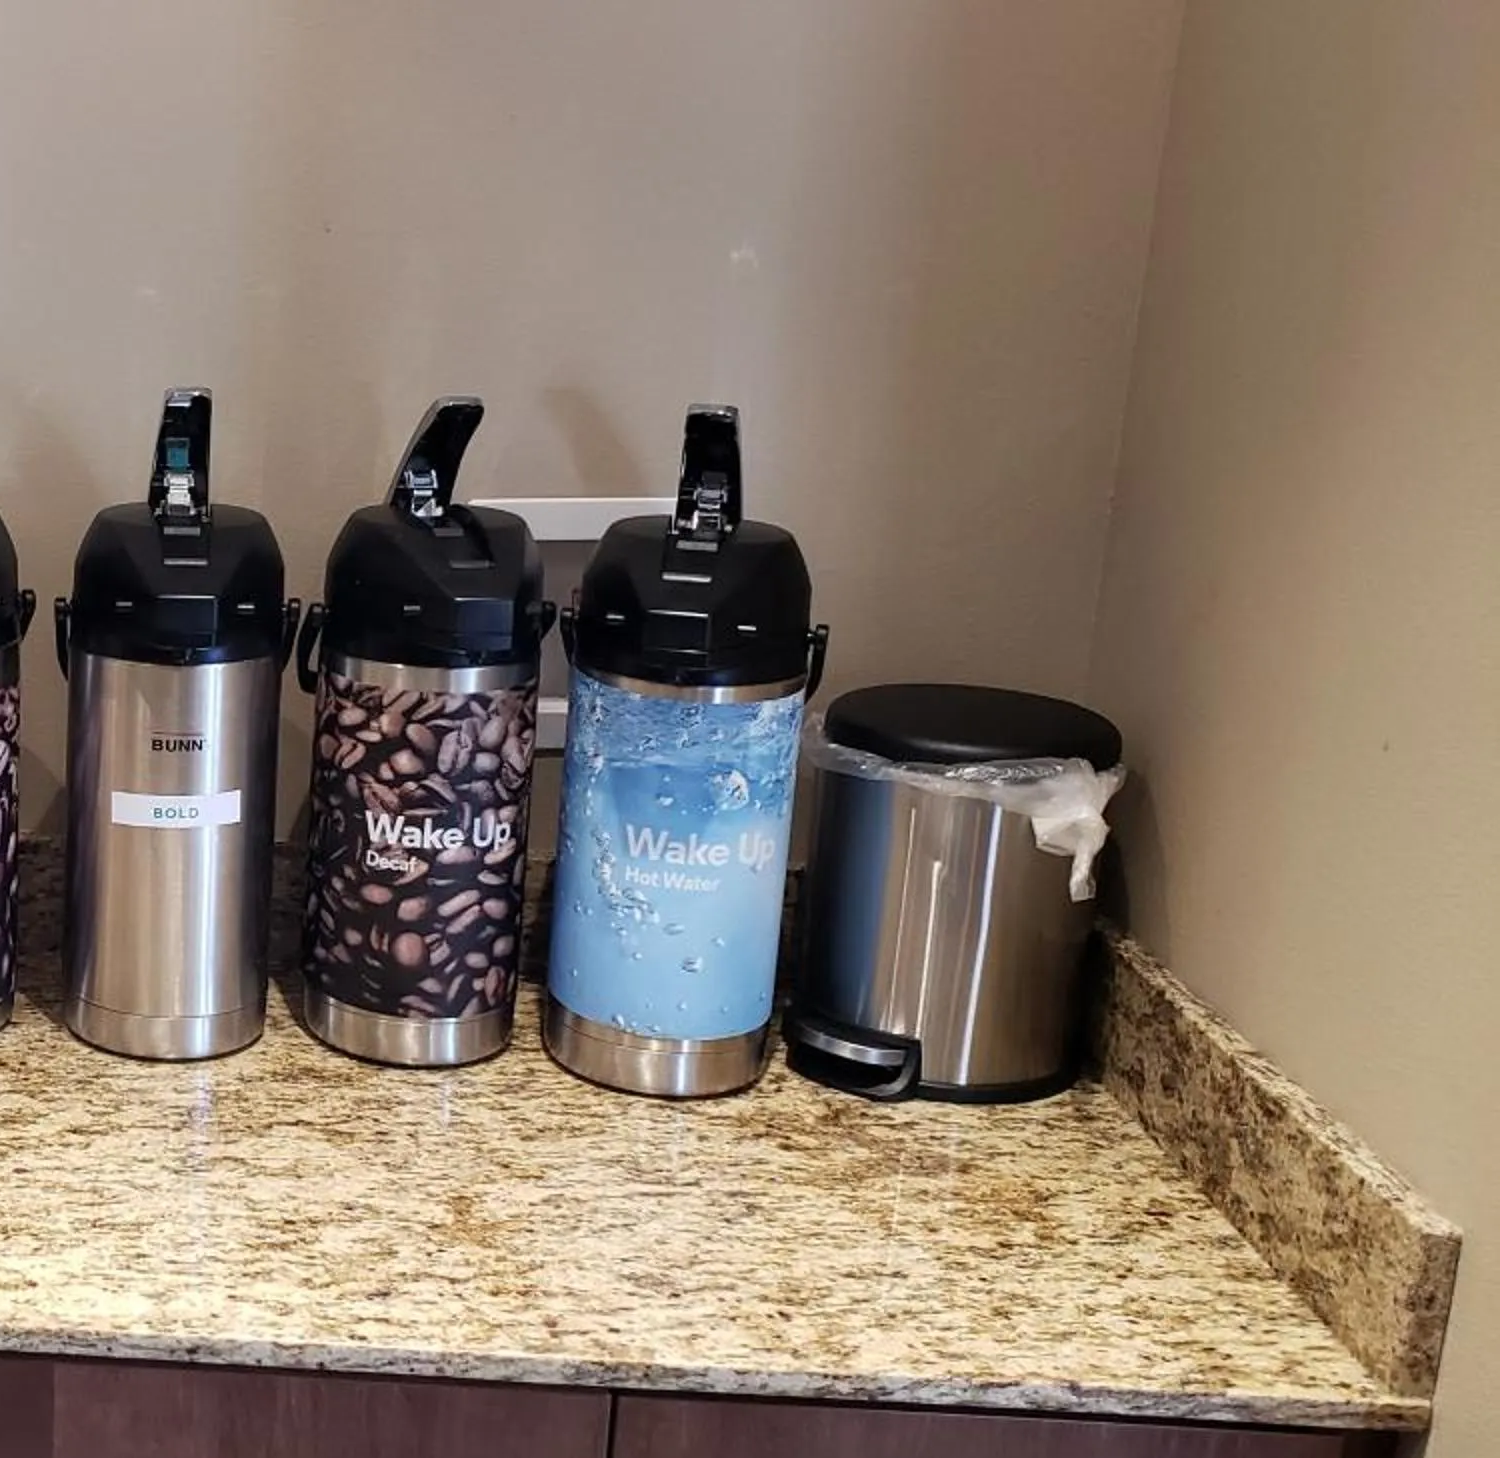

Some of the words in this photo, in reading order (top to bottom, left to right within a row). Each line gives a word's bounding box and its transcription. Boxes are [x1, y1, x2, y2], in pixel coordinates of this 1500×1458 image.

[151, 739, 204, 752] BUNN
[153, 807, 199, 819] BOLD
[365, 810, 466, 850] Wake
[472, 817, 511, 850] Up
[626, 824, 731, 867] Wake
[738, 832, 776, 871] Up
[366, 850, 417, 873] Decaf
[625, 865, 660, 887] Hot
[663, 870, 722, 892] Water
